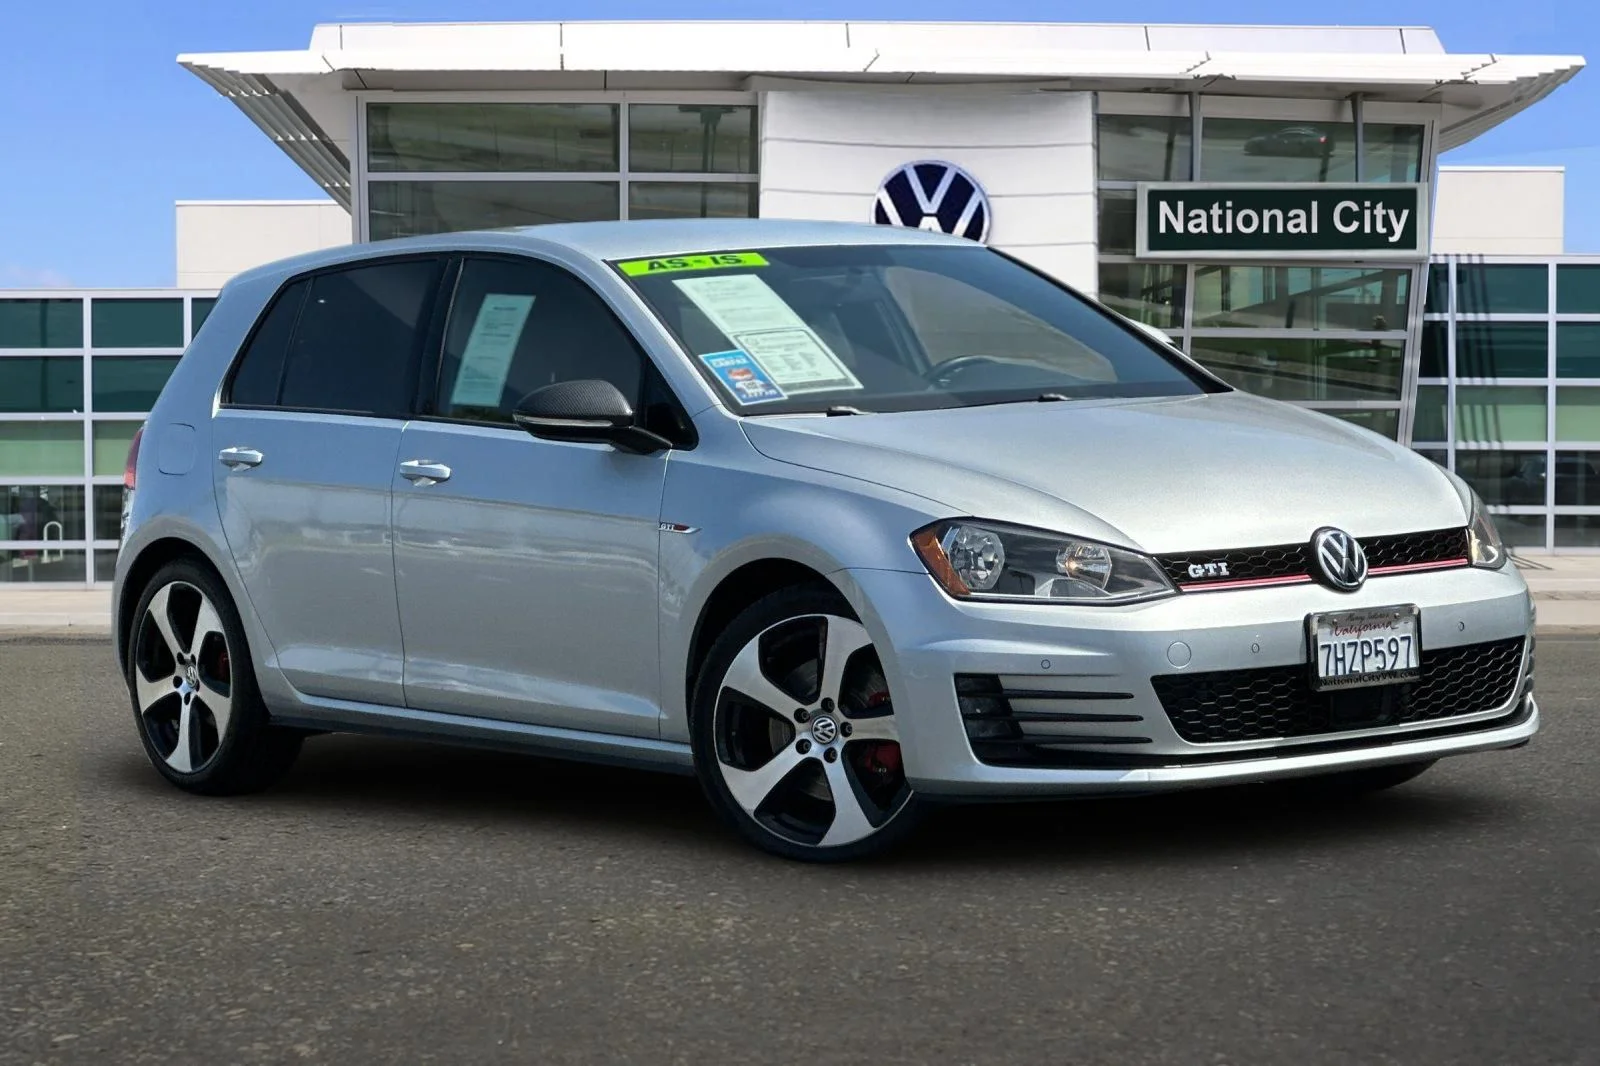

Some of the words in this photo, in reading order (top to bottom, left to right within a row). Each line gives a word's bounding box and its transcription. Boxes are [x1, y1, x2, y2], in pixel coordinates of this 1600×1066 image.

[1158, 200, 1318, 234] National
[1333, 200, 1409, 242] City
[1187, 561, 1230, 578] GTI
[1333, 620, 1398, 638] California
[1320, 635, 1412, 677] 7HZP597
